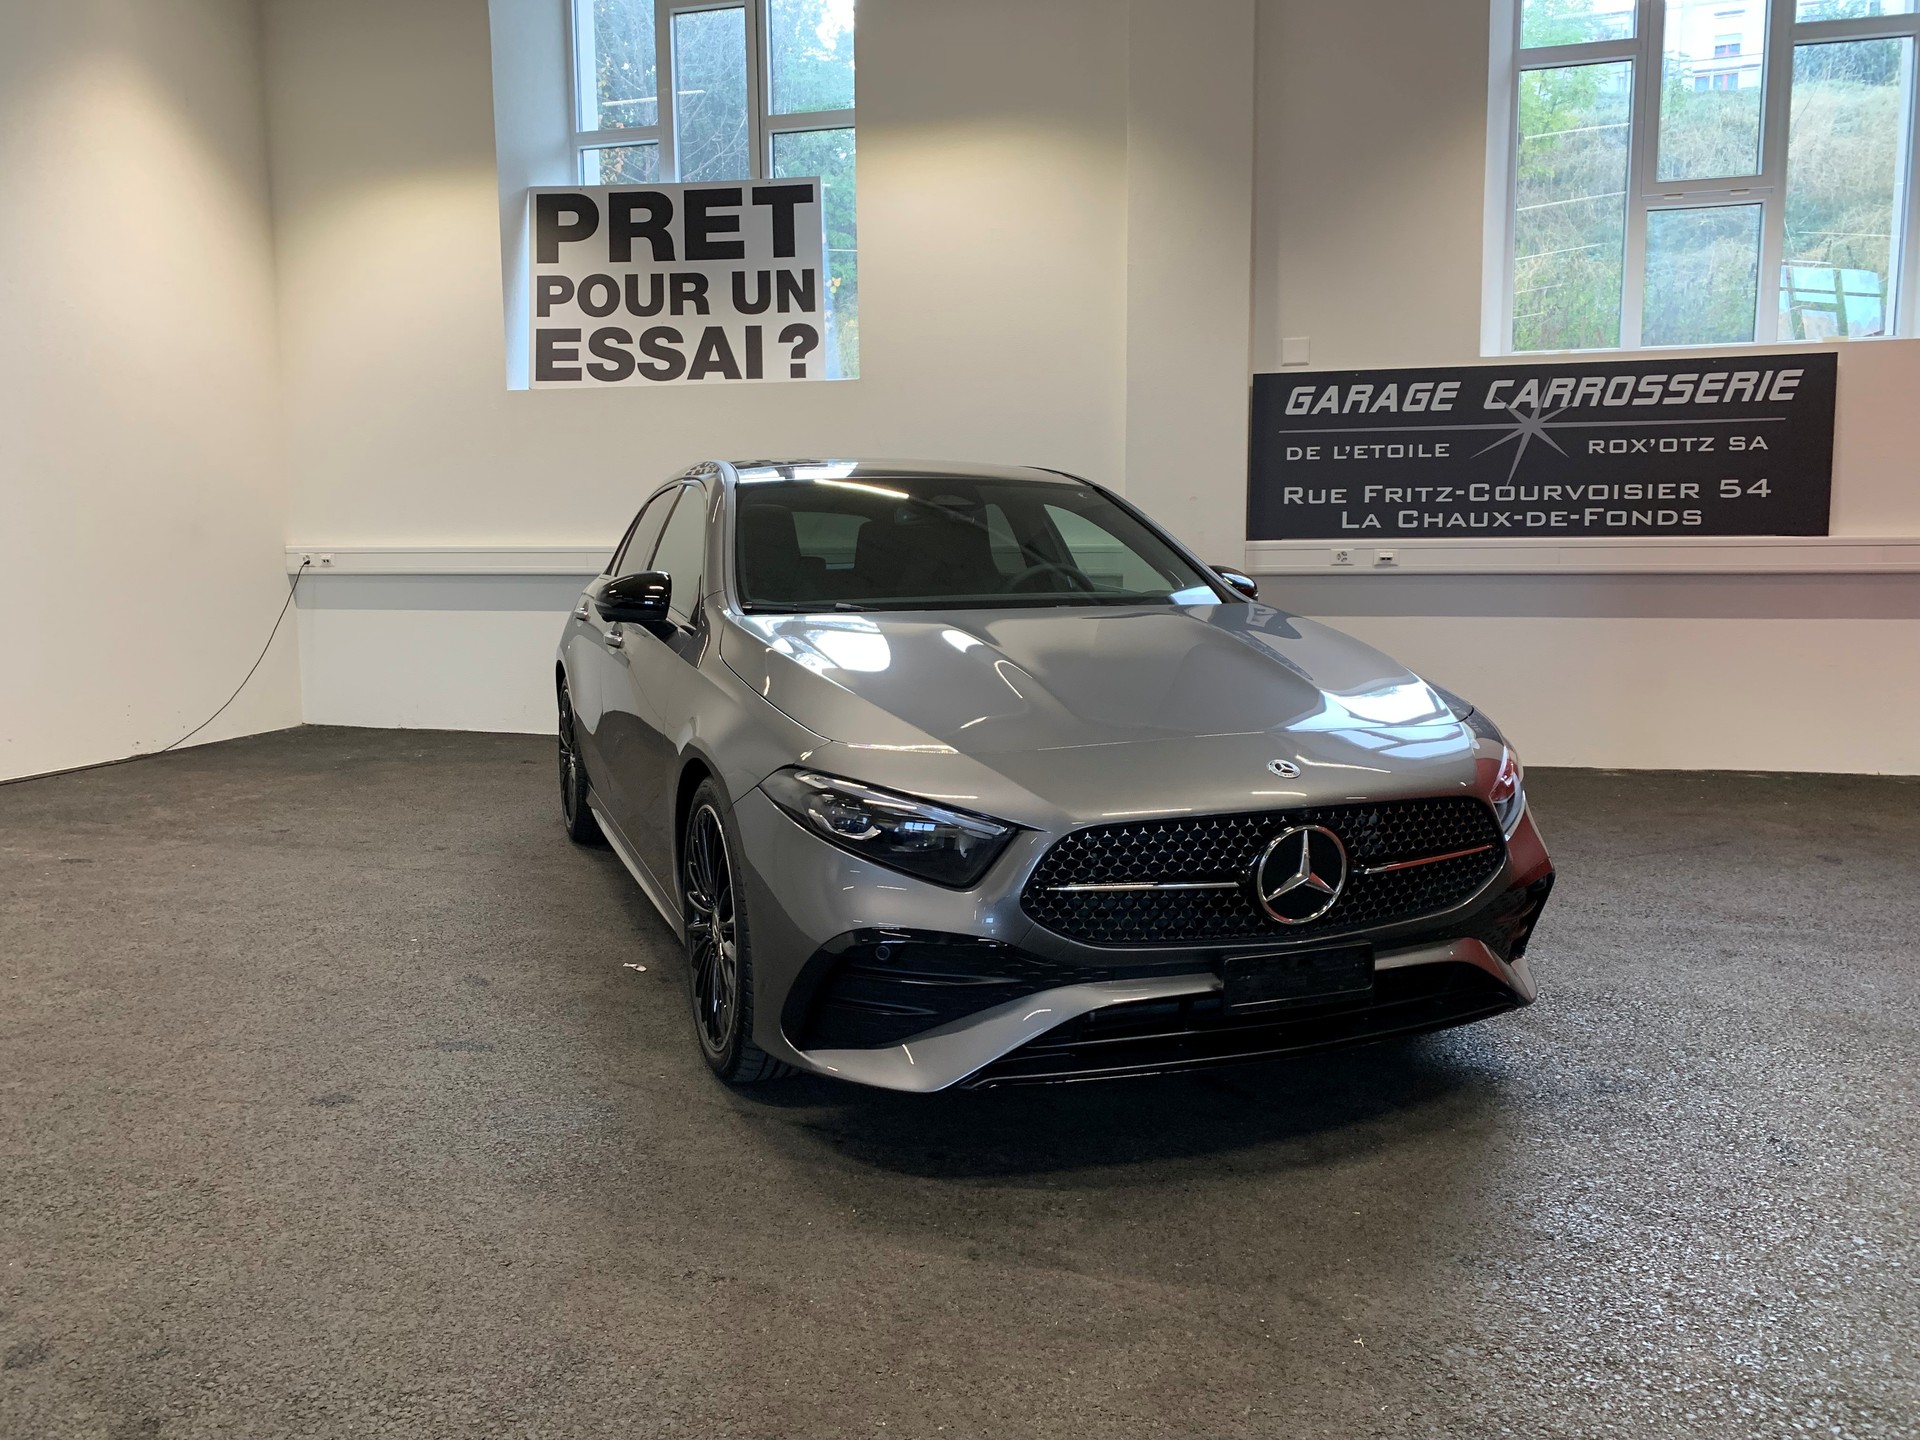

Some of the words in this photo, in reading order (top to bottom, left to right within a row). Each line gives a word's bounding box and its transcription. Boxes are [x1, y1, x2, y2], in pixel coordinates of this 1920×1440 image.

[536, 184, 814, 264] PRET
[536, 272, 710, 318] POUR
[732, 268, 816, 315] UN
[1285, 381, 1461, 415] GARAGE
[1483, 368, 1804, 410] CARROSSERIE
[1286, 446, 1321, 461] DE
[1333, 443, 1450, 460] L'ETOILE
[1588, 437, 1715, 454] ROX'OTZ
[1728, 435, 1769, 451] SA
[1719, 478, 1772, 498] 54
